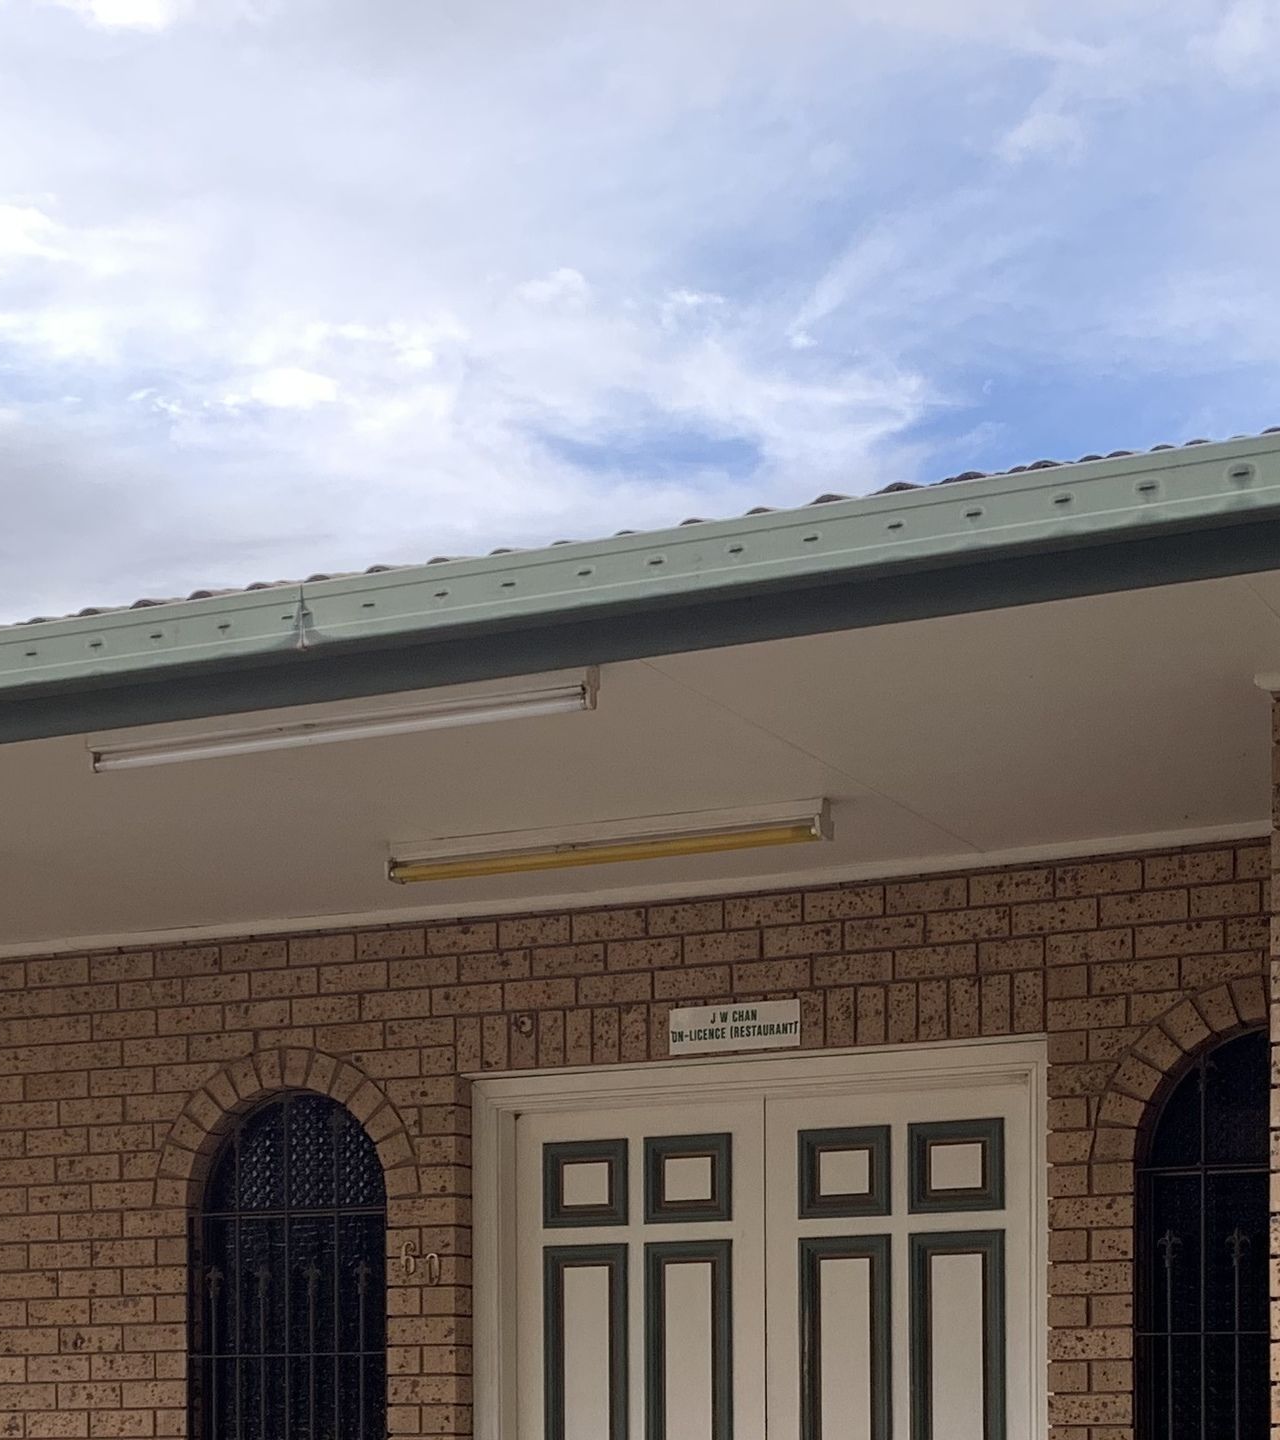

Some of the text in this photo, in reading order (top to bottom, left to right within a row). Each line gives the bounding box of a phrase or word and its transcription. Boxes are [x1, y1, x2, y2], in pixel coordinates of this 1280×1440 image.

[710, 1009, 757, 1024] J W CHAN
